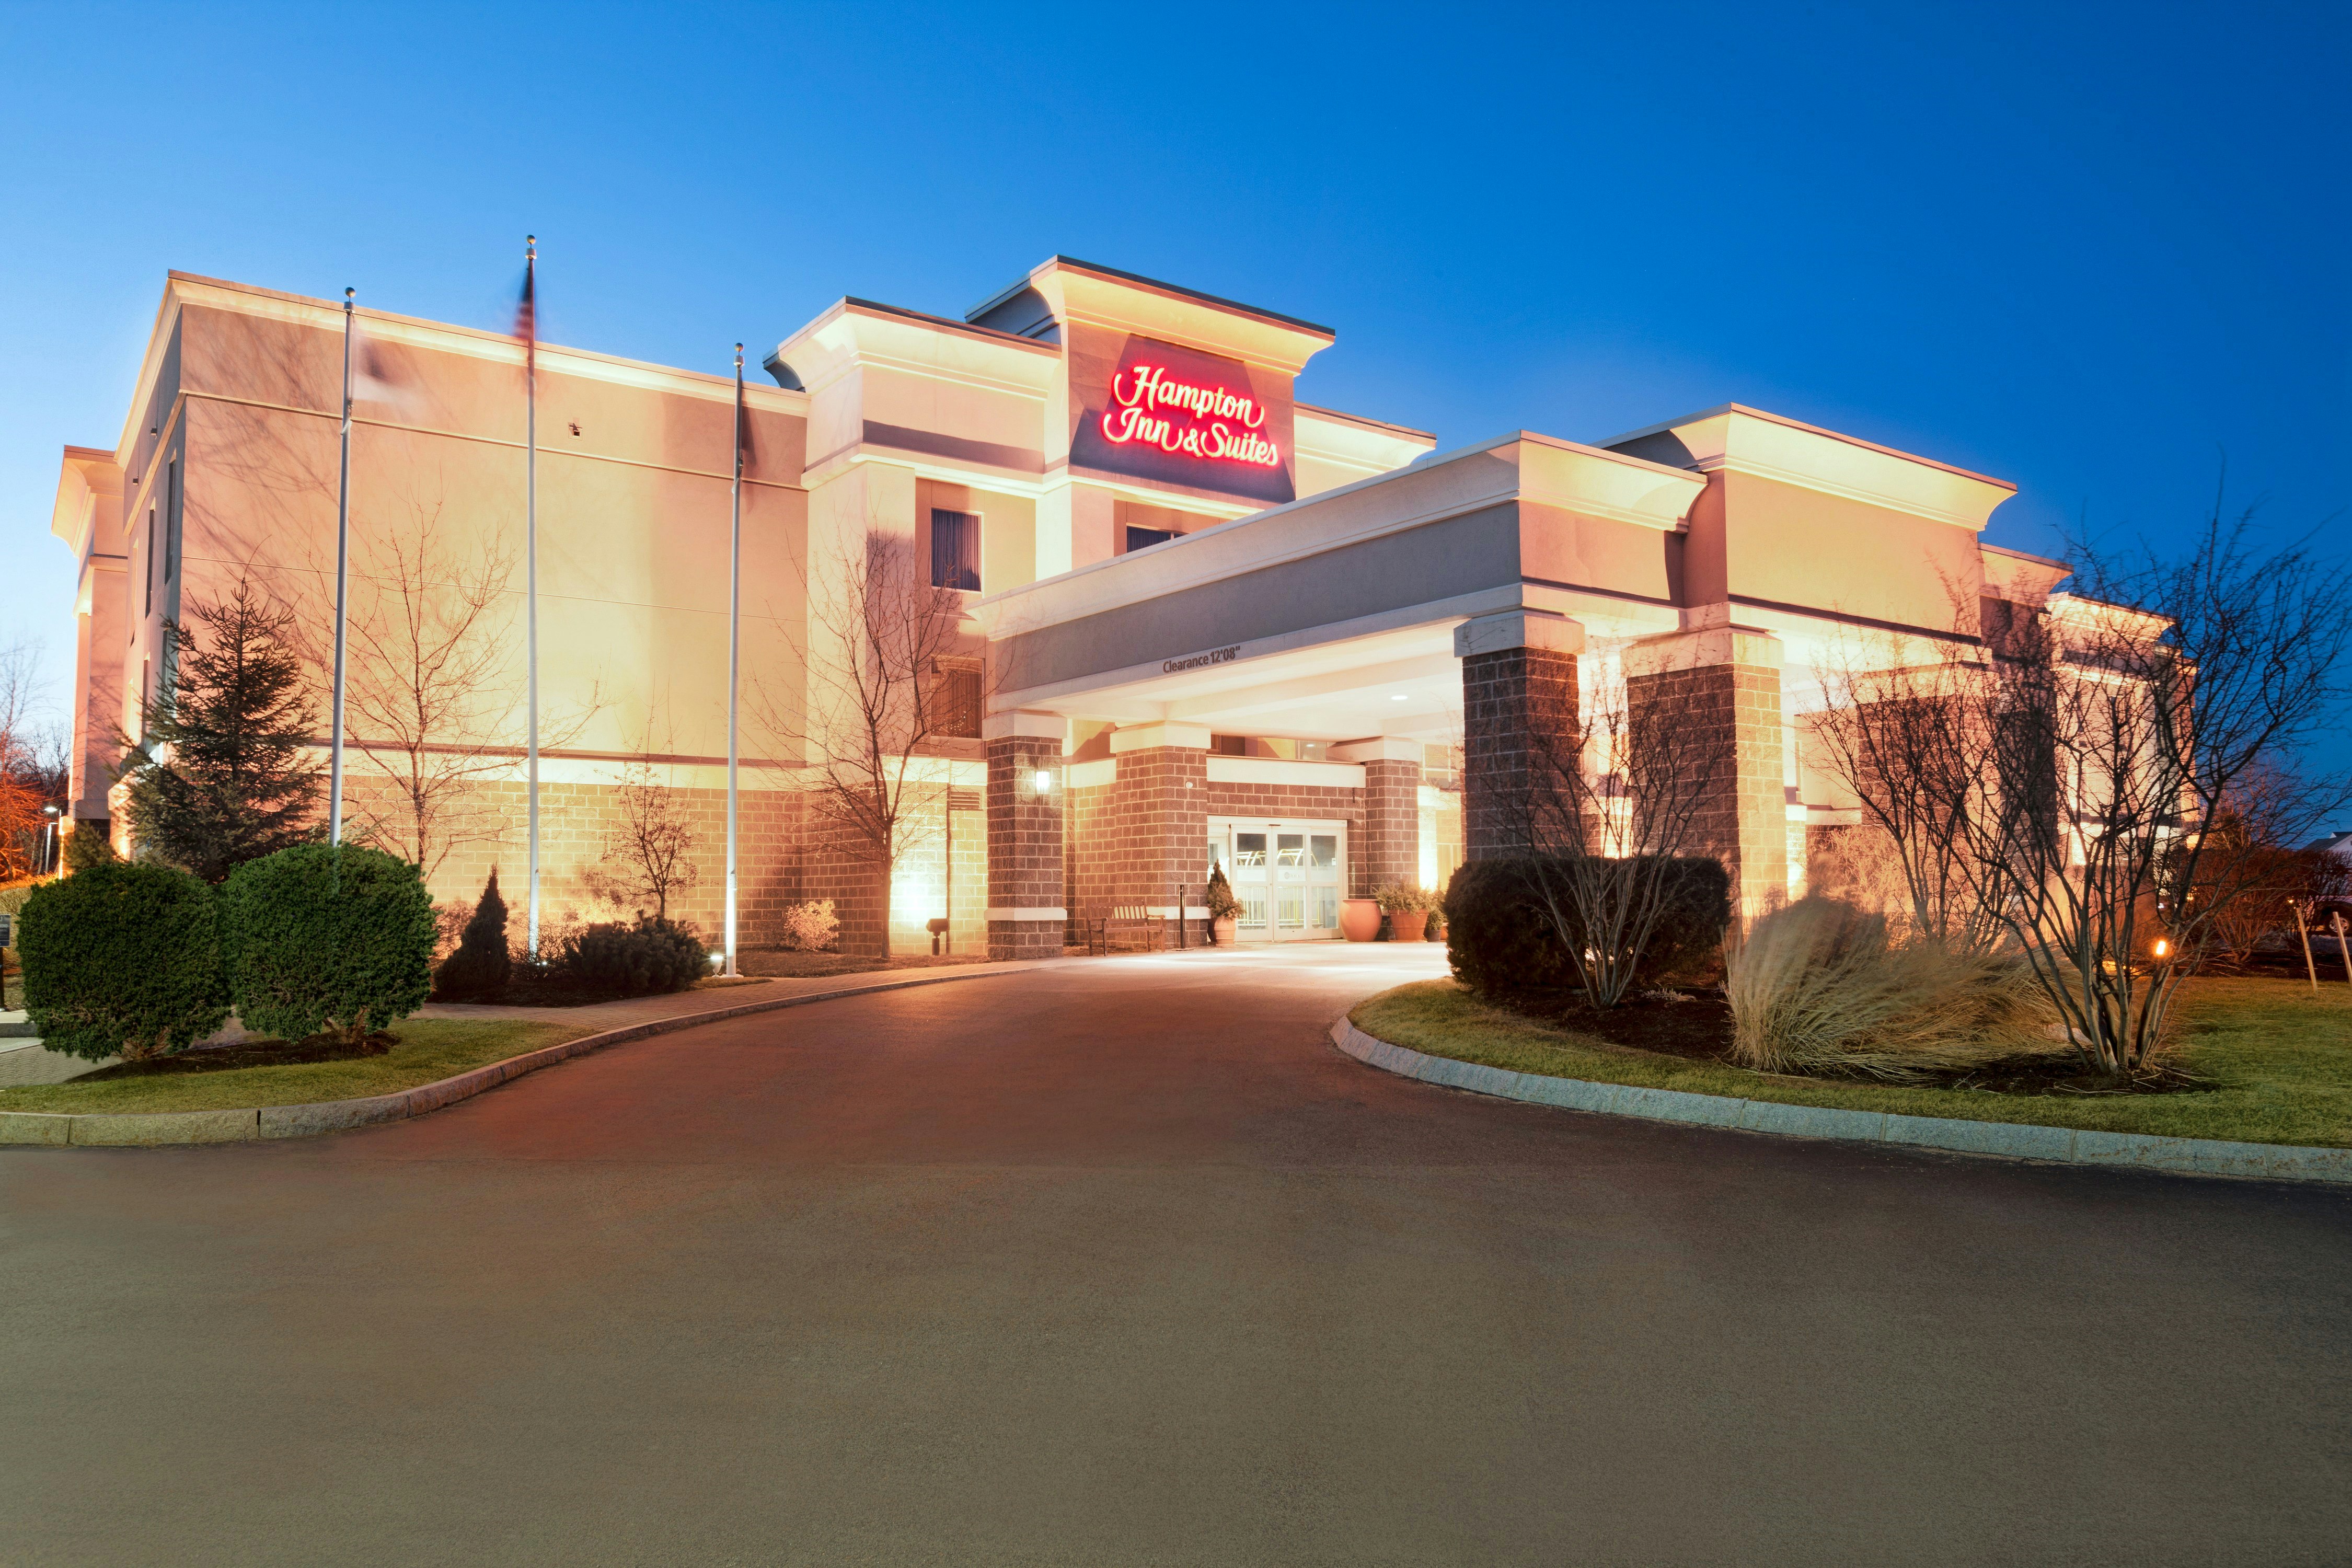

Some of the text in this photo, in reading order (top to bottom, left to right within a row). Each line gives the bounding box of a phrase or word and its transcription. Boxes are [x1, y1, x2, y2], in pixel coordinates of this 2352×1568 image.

[1113, 366, 1265, 428] Hampton
[1103, 407, 1183, 452] Inn
[1201, 422, 1278, 466] Suites
[1162, 645, 1241, 674] Clearance 12'08"
